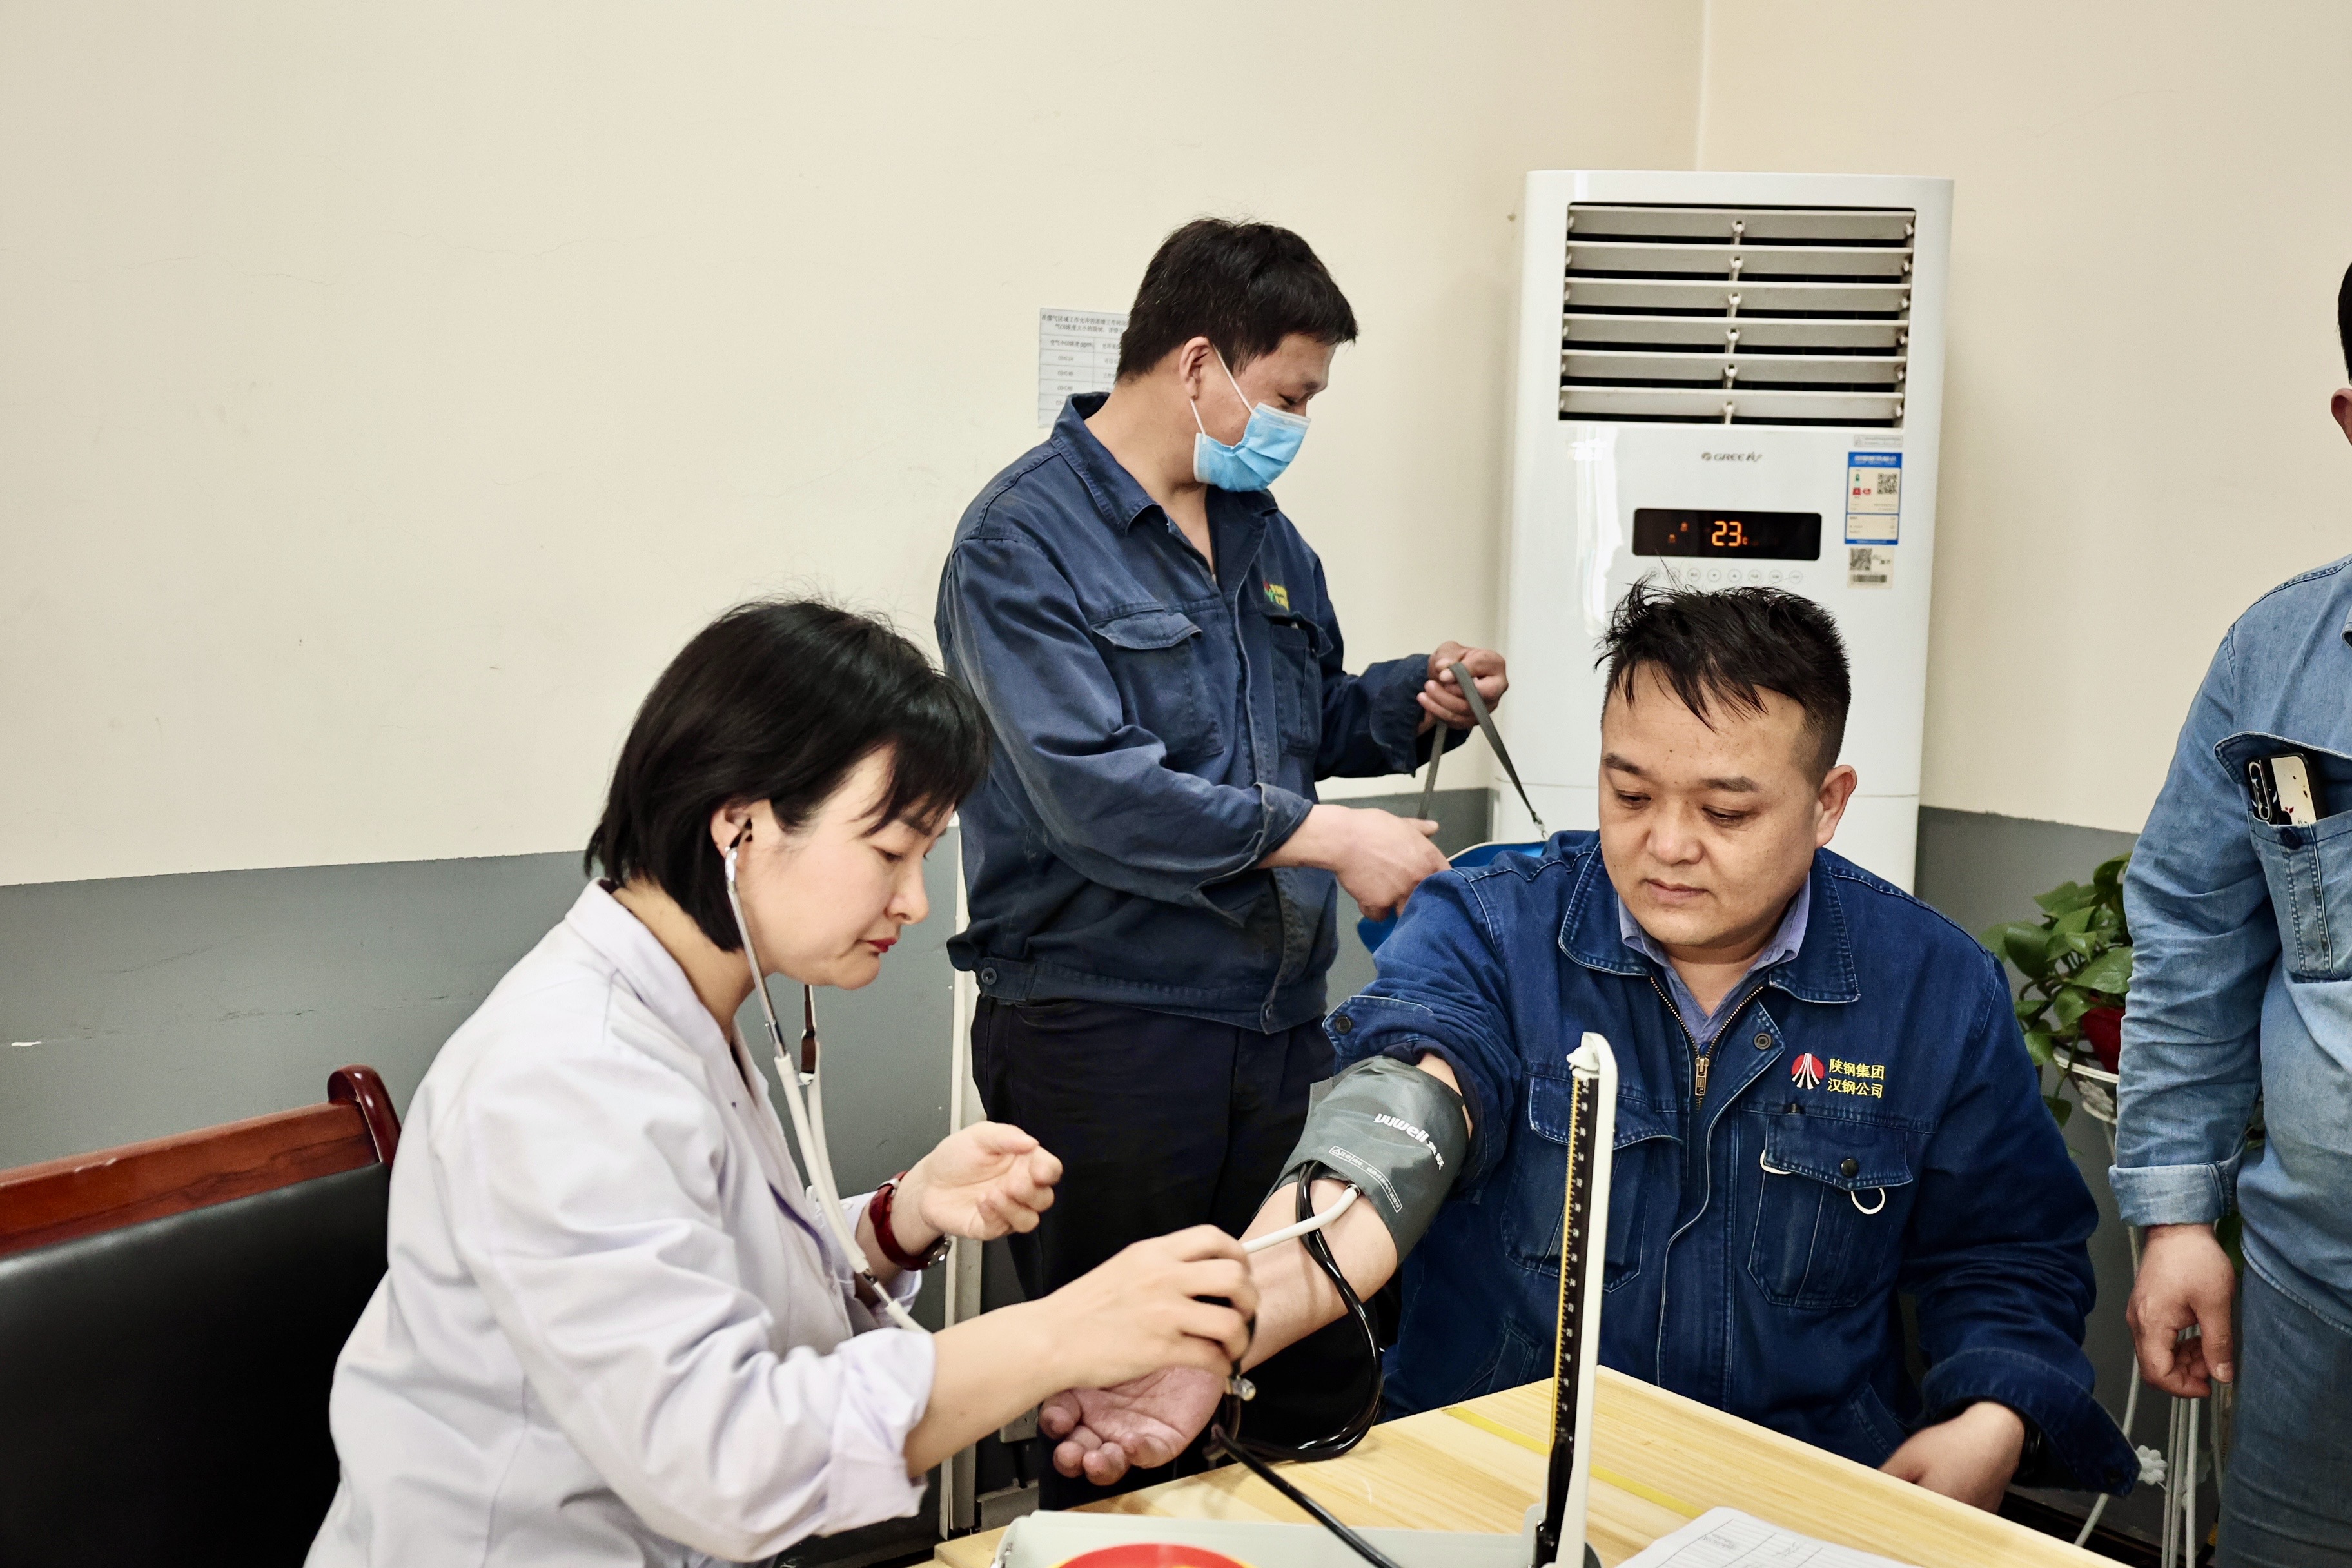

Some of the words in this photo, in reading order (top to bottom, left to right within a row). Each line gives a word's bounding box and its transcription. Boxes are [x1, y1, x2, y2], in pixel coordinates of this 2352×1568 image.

[1711, 520, 1742, 547] 23
[1828, 1058, 1885, 1080] 陕钢集团
[1827, 1077, 1883, 1099] 汉钢公司
[1373, 1113, 1429, 1143] yuwell
